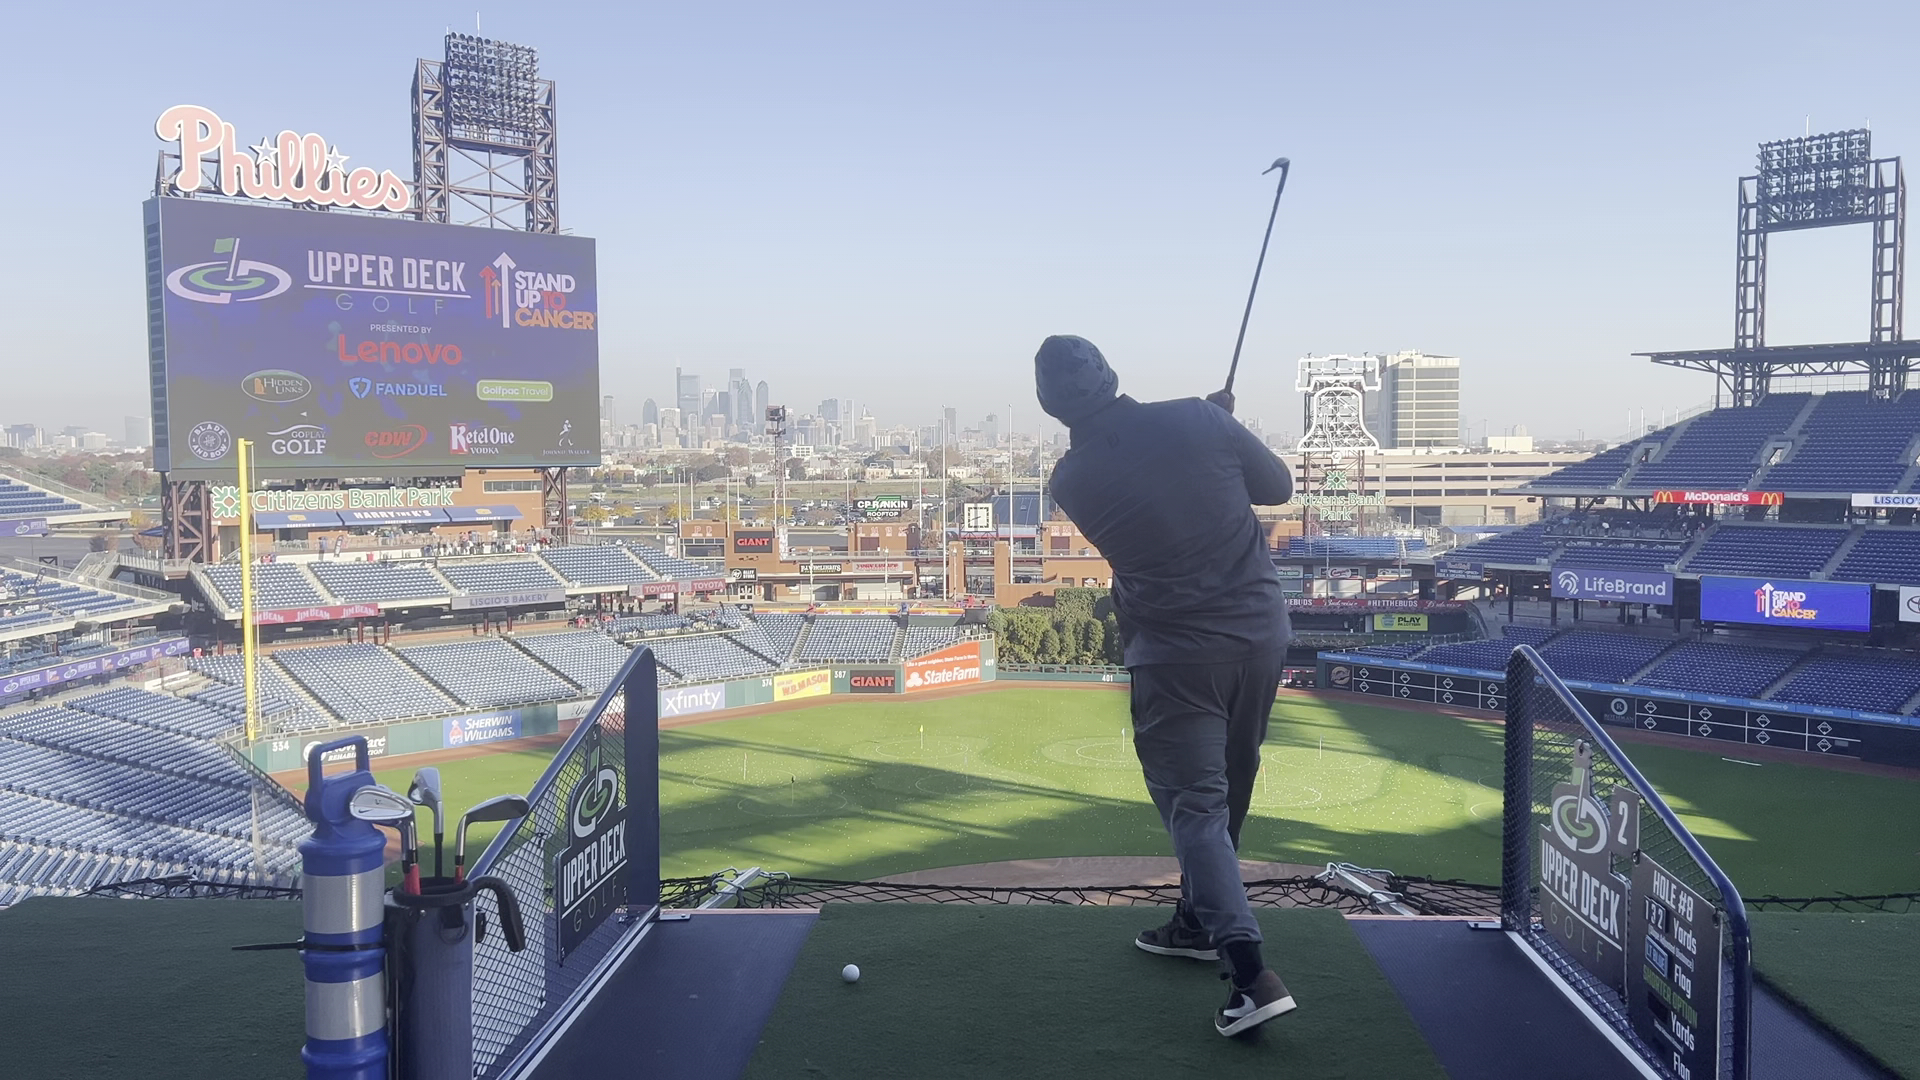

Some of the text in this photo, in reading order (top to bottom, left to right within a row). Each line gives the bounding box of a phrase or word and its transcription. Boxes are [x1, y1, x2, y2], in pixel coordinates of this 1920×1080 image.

[156, 104, 411, 211] Phillies
[307, 249, 467, 293] UPPER DECK
[514, 270, 576, 293] STAND
[336, 293, 443, 316] GOLF
[515, 290, 567, 311] UP TO
[514, 308, 595, 331] CANCER
[370, 323, 432, 334] PRESENTED BY
[338, 333, 462, 365] Lenovo
[264, 377, 303, 388] HIDDEN
[275, 385, 304, 395] LINKS
[375, 382, 448, 397] FANDUEL
[482, 386, 549, 398] Golfpac Travel
[193, 423, 226, 437] BLADE
[364, 430, 413, 447] CDW
[191, 442, 228, 459] AND BOW
[271, 438, 327, 455] GOLF
[469, 446, 499, 455] VODKA
[251, 485, 454, 511] Citizens Bank Park
[1289, 491, 1384, 506] Citizens Bank
[1684, 491, 1749, 502] McDonald's
[1874, 495, 1920, 505] LISCIO'
[857, 500, 871, 509] CP
[353, 510, 395, 519] HARRY
[1319, 506, 1352, 521] Park
[737, 538, 769, 546] GIANT
[644, 584, 677, 593] TOYOTA
[693, 581, 724, 590] TOYOTA
[1584, 576, 1666, 596] LifeBrand
[469, 593, 549, 607] LISCIO'S BAKERY
[1772, 590, 1806, 602] STAND
[340, 604, 375, 618] JIM BEAM
[1367, 600, 1418, 608] #HITTHEBUDS
[1772, 599, 1801, 609] UP TO
[262, 610, 284, 623] BEAM
[294, 607, 330, 622] JIM BEAM
[1771, 608, 1816, 620] CANCER
[985, 658, 994, 667] 409
[761, 678, 773, 688] 374
[851, 676, 895, 687] GIANT
[1101, 674, 1113, 682] 401
[665, 688, 721, 714] xfinity
[465, 714, 513, 731] SHERWIN
[271, 740, 290, 752] 334
[1617, 800, 1629, 846] 2
[563, 818, 627, 908] UPPER DECK
[1541, 838, 1621, 940] UPPER DECK
[1653, 869, 1694, 923] HOLE #8
[573, 875, 617, 933] GOLF
[1645, 899, 1663, 930] 132
[1551, 900, 1603, 963] GOLF
[1673, 917, 1697, 955] Yards
[1674, 963, 1692, 999] Flag
[1672, 991, 1698, 1029] OPTION
[1671, 1010, 1695, 1052] Yards
